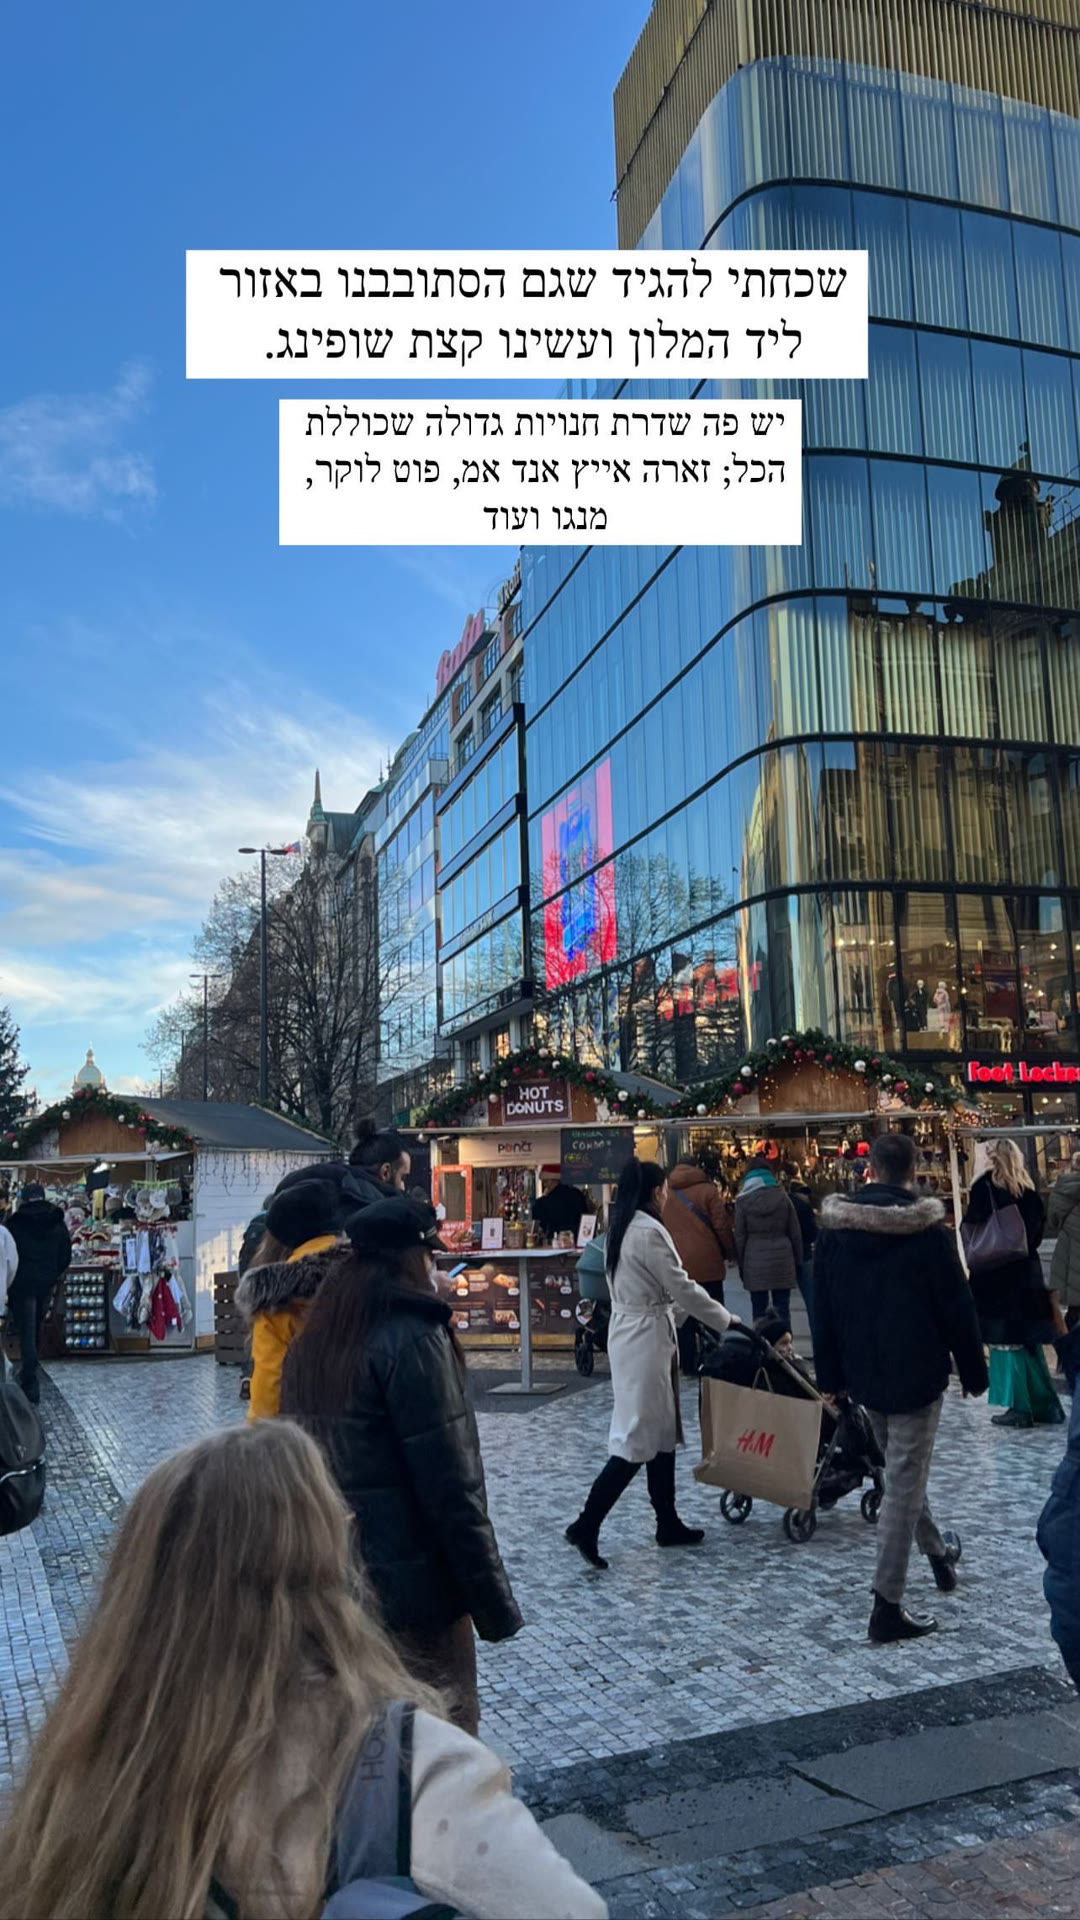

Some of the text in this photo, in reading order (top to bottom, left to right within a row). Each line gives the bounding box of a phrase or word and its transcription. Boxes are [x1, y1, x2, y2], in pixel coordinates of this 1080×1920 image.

[968, 1061, 1080, 1082] Foot Locke
[519, 1085, 550, 1101] HOT
[506, 1100, 565, 1116] DONUTS
